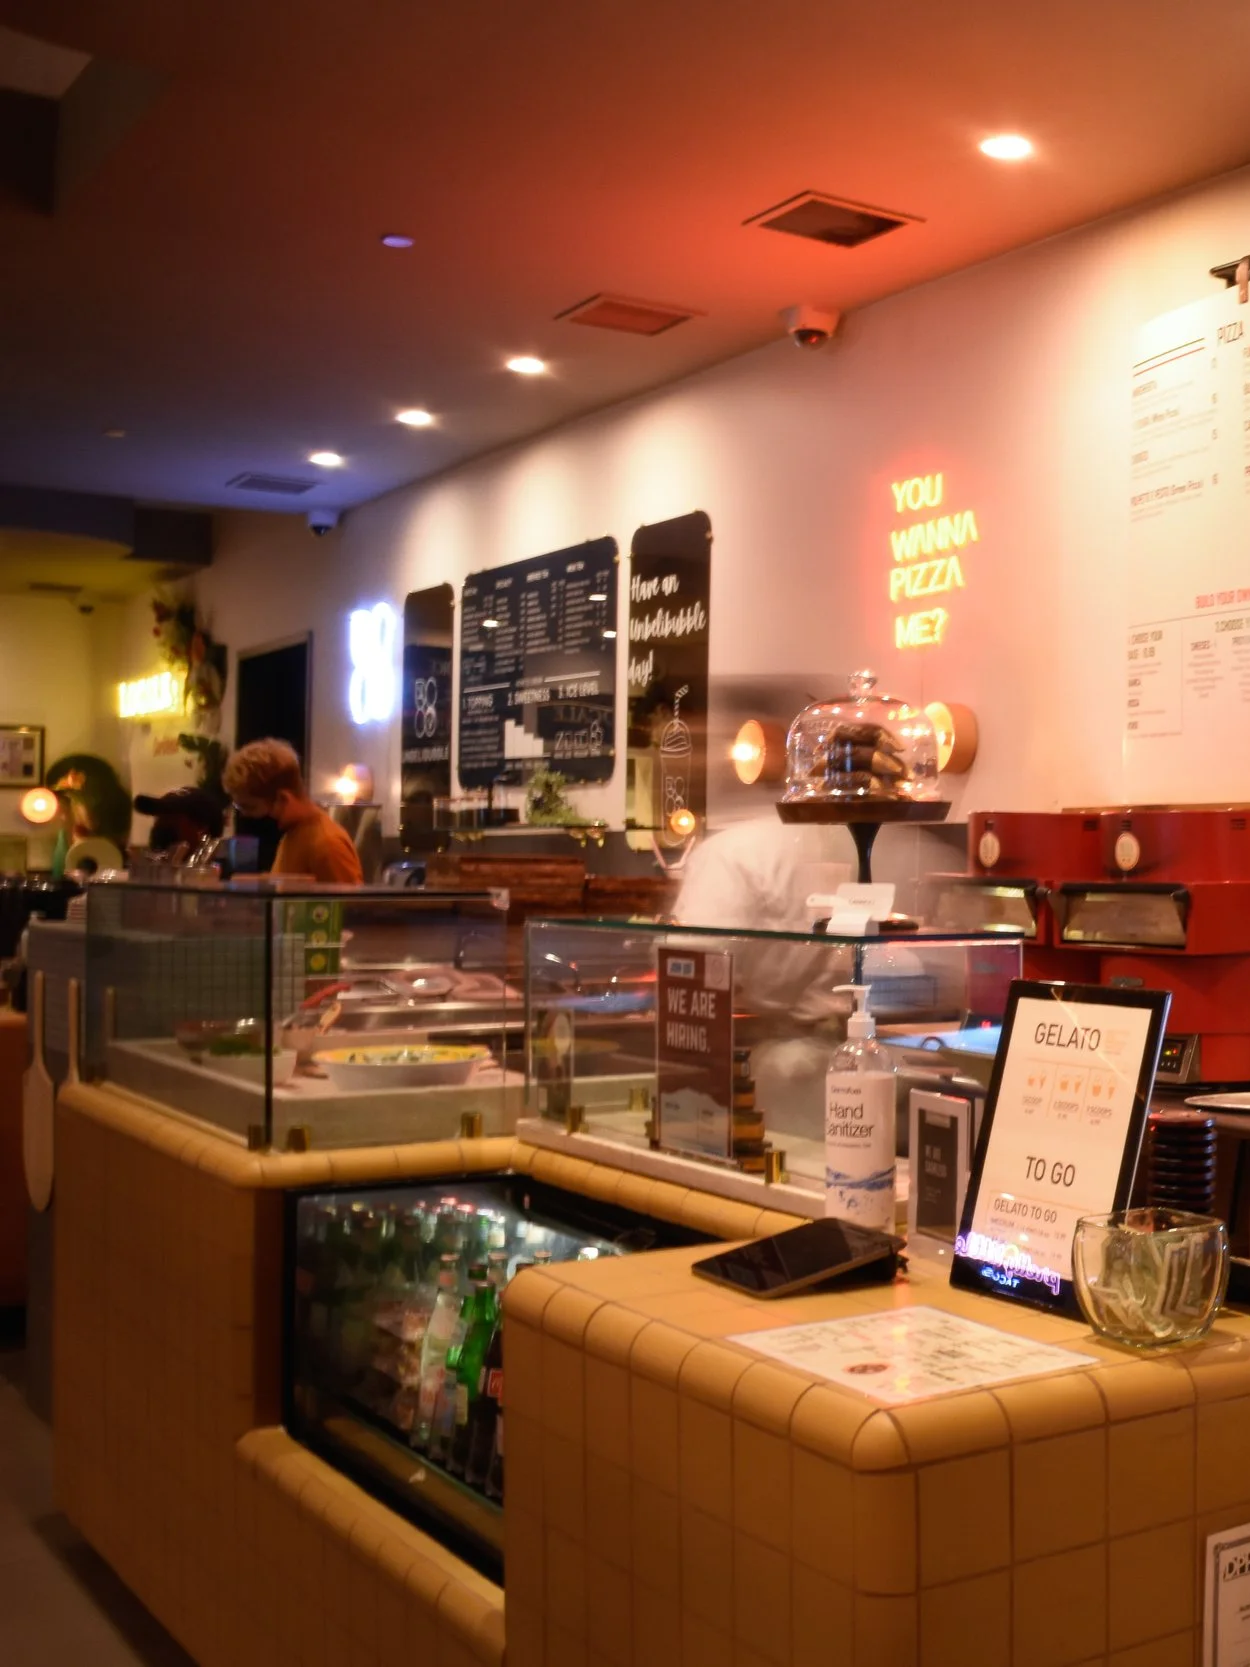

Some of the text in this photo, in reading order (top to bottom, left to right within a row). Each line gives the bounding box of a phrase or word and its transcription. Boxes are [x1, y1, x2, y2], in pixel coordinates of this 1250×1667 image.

[891, 472, 943, 513] YOU
[890, 509, 980, 562] WANNA
[631, 573, 680, 603] Have an
[889, 555, 965, 603] PIZZA
[894, 607, 949, 650] ME?
[628, 649, 654, 687] day!
[667, 987, 717, 1020] WE ARE
[666, 1020, 711, 1053] HIRING.
[1034, 1022, 1101, 1051] GELATO
[829, 1102, 864, 1120] Hand
[1025, 1155, 1076, 1188] TO GO
[994, 1198, 1057, 1224] GELATO TO GO
